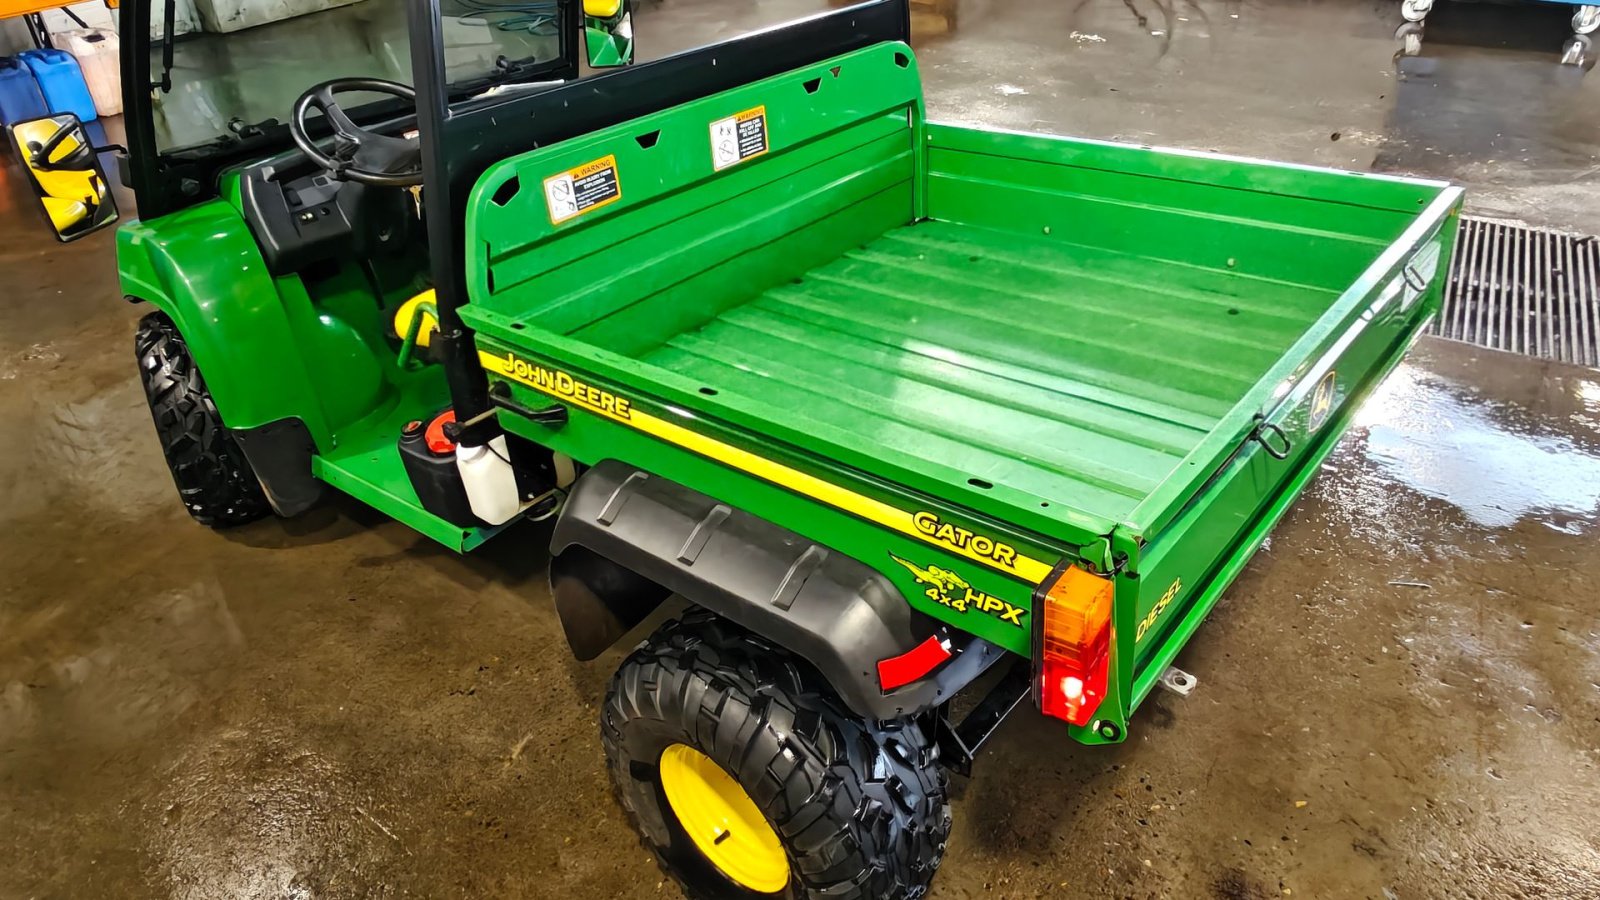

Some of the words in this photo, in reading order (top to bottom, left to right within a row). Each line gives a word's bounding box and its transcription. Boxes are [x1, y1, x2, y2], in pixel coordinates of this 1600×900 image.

[580, 159, 611, 176] WARNING
[913, 511, 1015, 568] GATOR
[964, 587, 1026, 628] HPX
[1135, 576, 1182, 643] DIESEL
